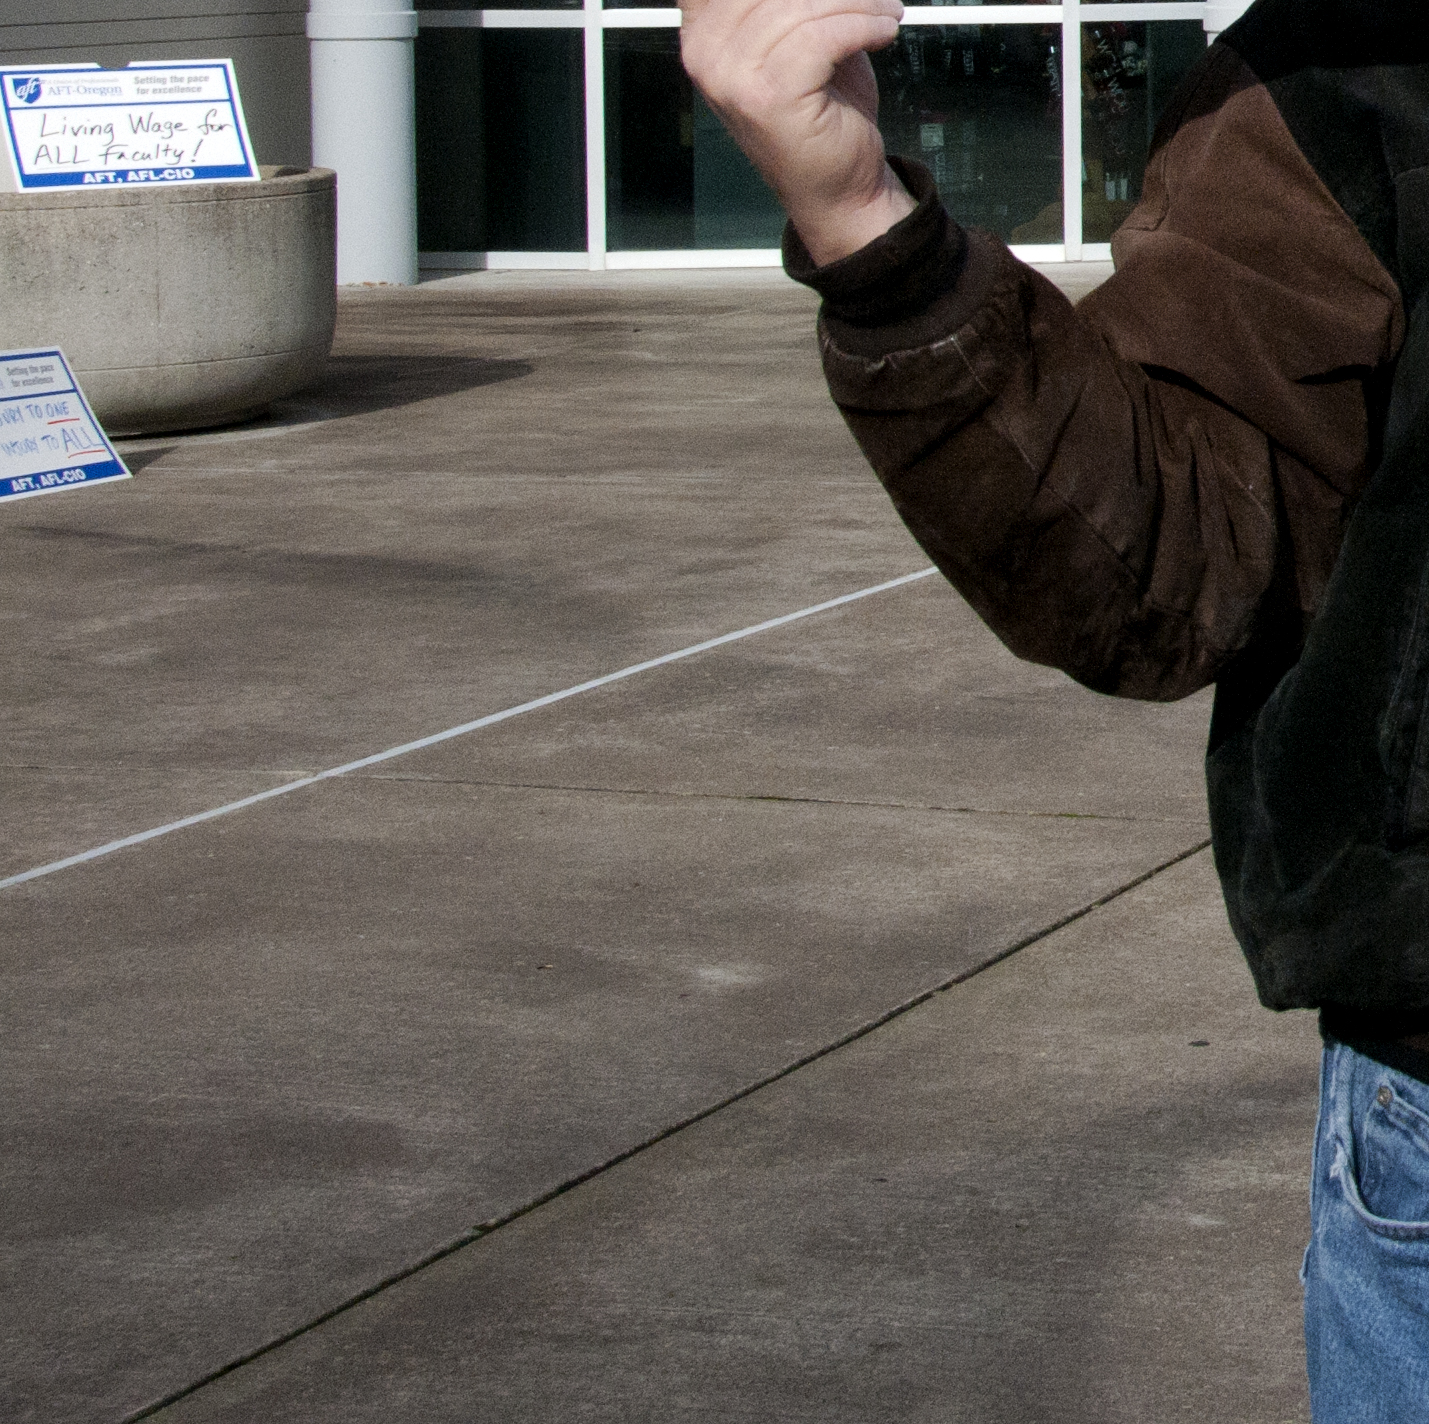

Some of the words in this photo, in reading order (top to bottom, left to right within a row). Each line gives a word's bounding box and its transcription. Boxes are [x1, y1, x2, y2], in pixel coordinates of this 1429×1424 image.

[39, 112, 115, 147] Living
[128, 111, 189, 139] Wage
[197, 108, 234, 136] for
[33, 144, 91, 166] ALL
[83, 171, 124, 184] AFT,
[127, 168, 196, 182] AFL-CIO
[61, 427, 106, 453] ALL
[42, 468, 87, 487] AFL-CIO
